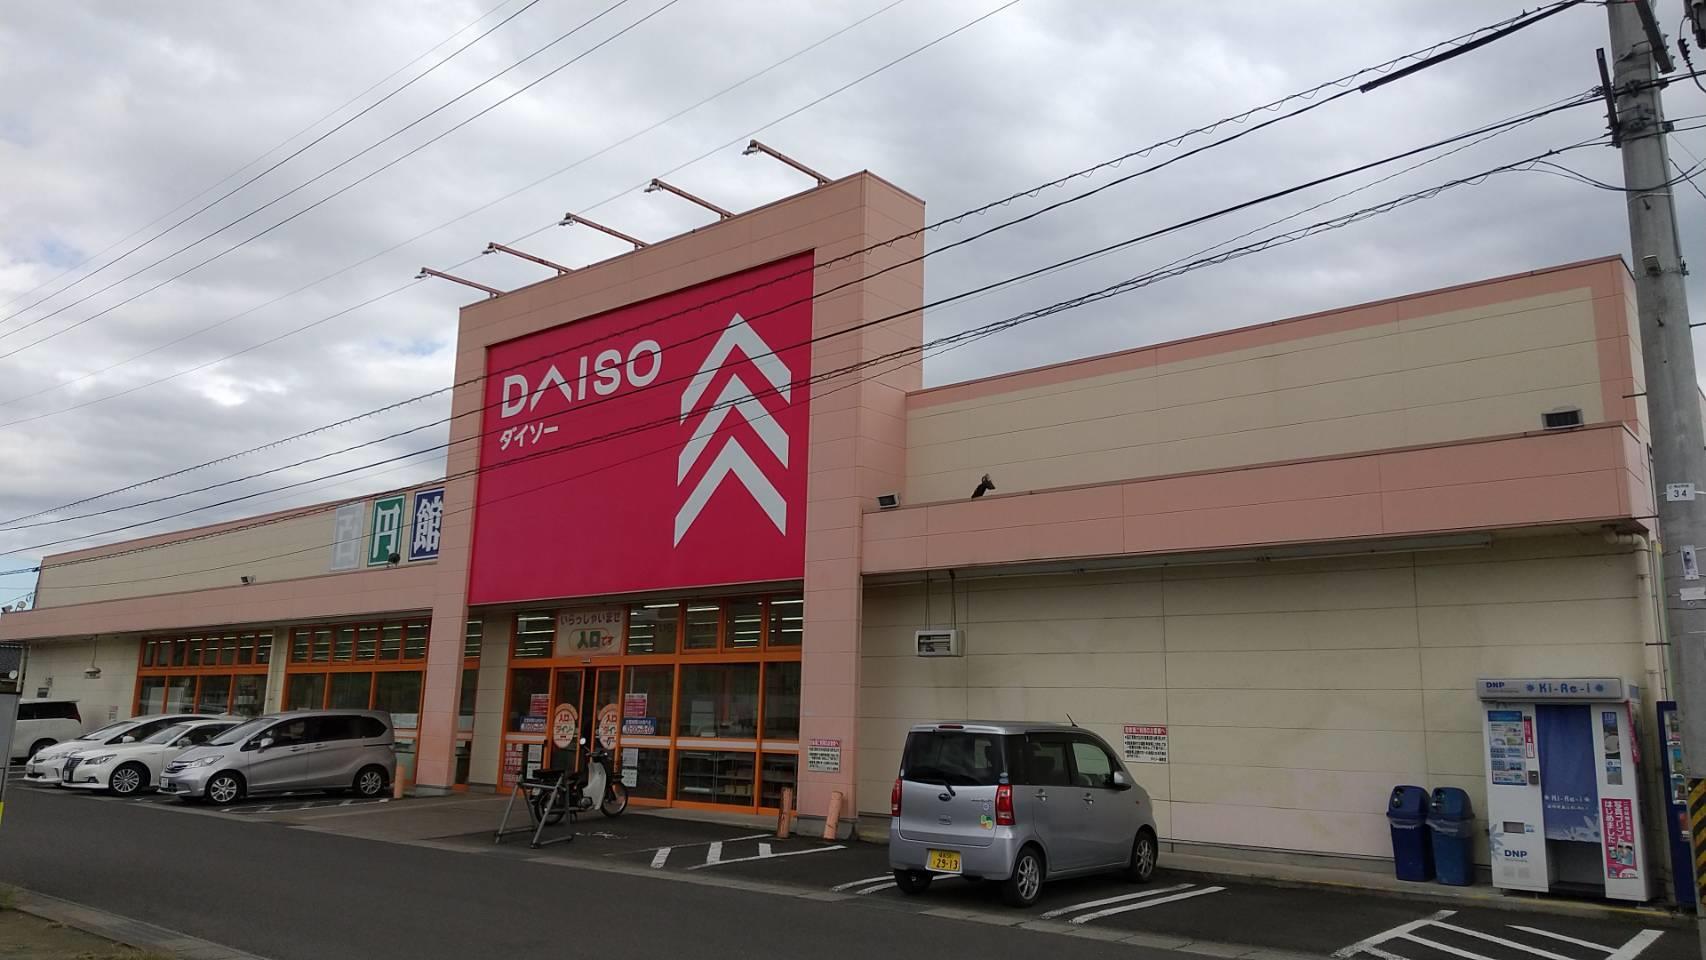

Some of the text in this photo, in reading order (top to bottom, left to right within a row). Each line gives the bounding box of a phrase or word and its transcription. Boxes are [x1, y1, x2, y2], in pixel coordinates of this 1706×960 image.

[501, 339, 662, 419] DAISO
[499, 422, 559, 451] ダイソー
[560, 611, 621, 625] いらっしゃいませ
[1539, 682, 1591, 694] Ki-Re-i
[1504, 849, 1528, 858] DNP
